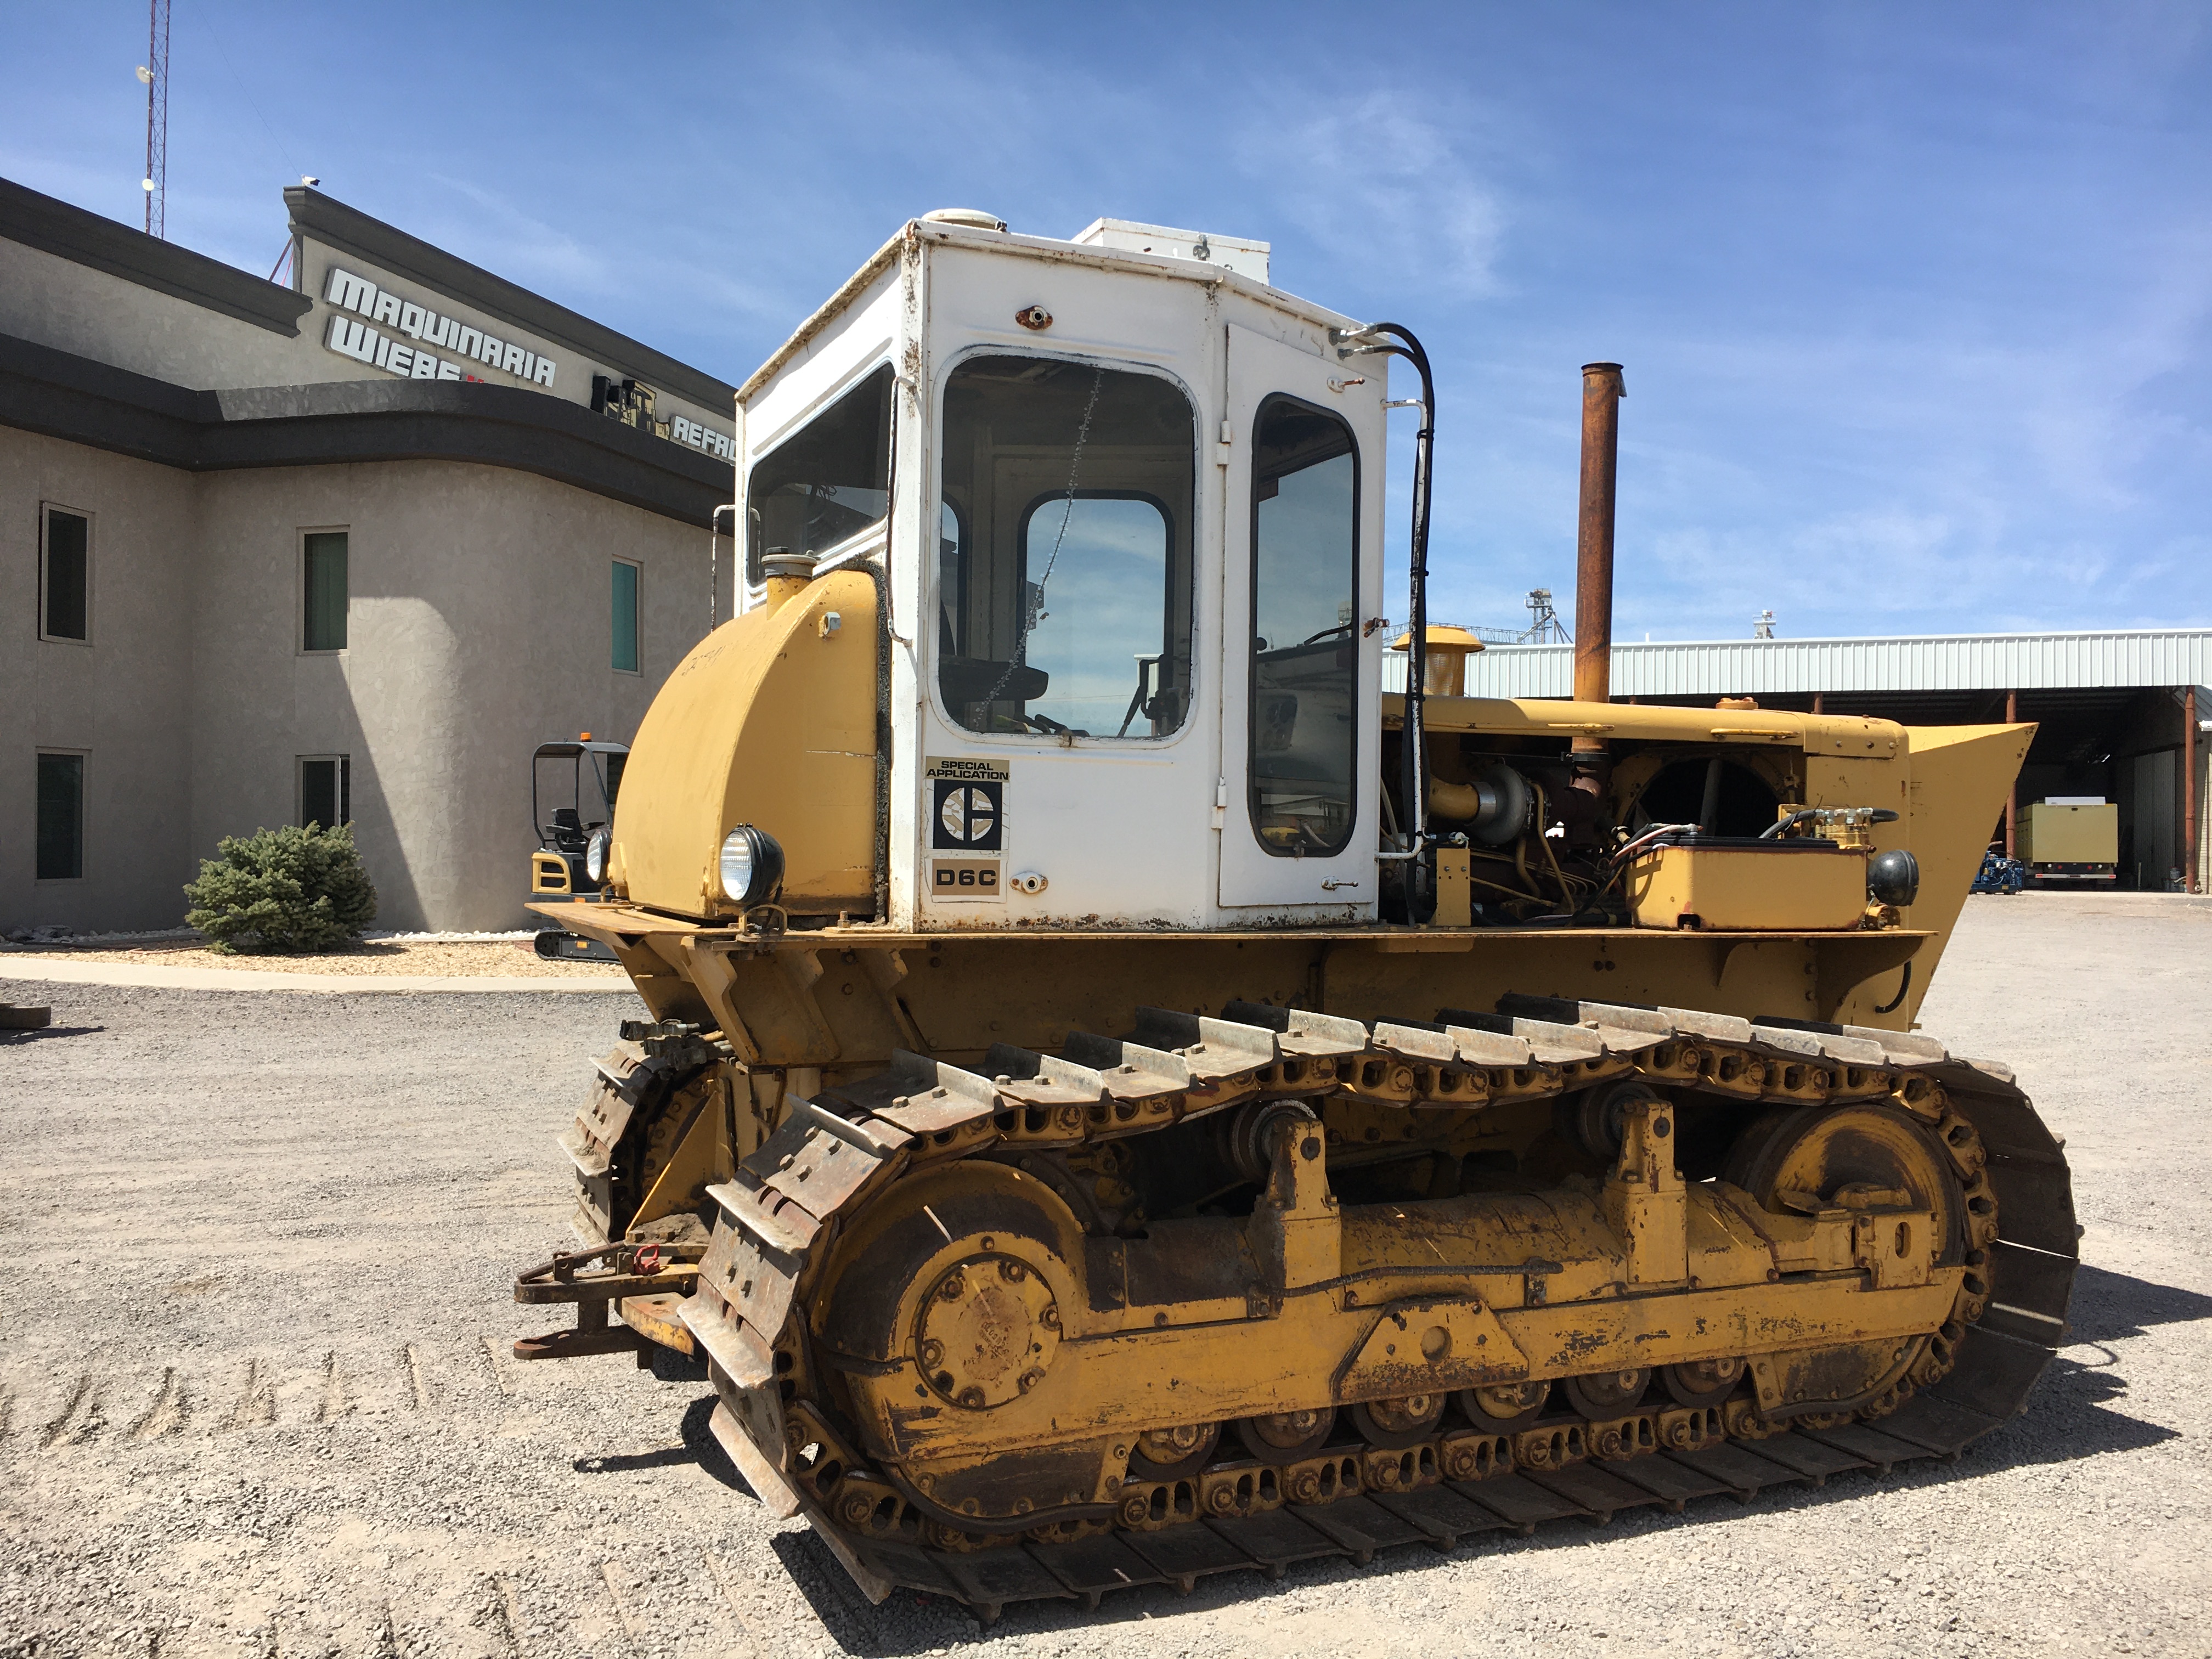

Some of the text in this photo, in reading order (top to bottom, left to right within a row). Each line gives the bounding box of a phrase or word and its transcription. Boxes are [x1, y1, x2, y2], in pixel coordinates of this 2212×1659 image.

[329, 268, 556, 387] MAQUINARIA
[941, 760, 994, 771] SPECIAL
[927, 769, 1008, 780] APPLICATION
[936, 870, 996, 886] D6C
